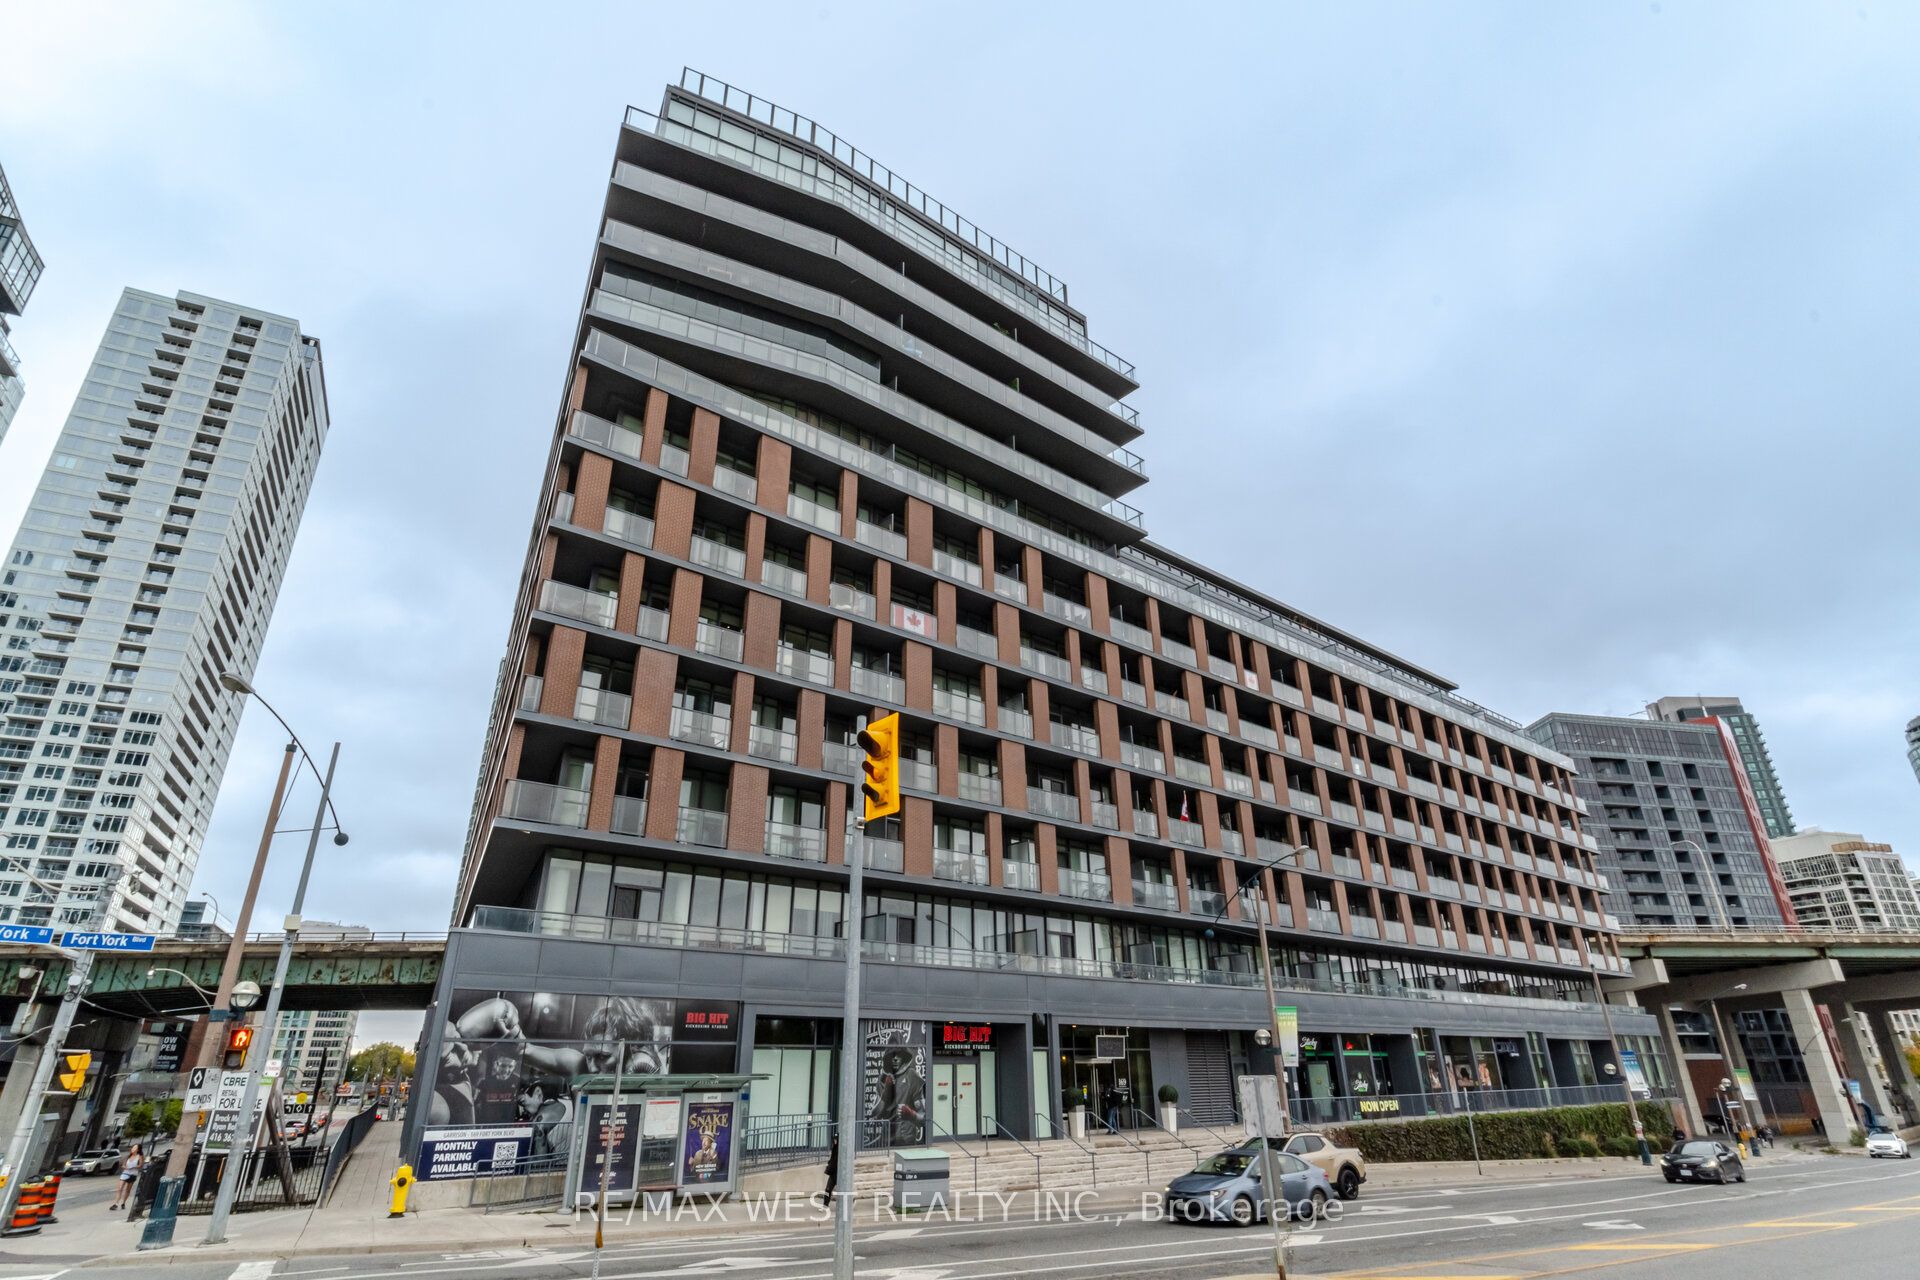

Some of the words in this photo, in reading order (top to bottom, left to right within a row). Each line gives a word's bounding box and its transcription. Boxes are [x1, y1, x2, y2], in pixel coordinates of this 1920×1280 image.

[70, 933, 98, 946] Fort
[101, 935, 128, 947] York
[687, 1012, 706, 1024] BIG
[709, 1013, 729, 1024] HIT
[944, 1026, 966, 1041] BIG
[969, 1026, 991, 1041] HIT
[223, 1077, 247, 1087] CBRE
[191, 1094, 212, 1105] ENDS
[219, 1098, 235, 1109] FOR
[1360, 1101, 1379, 1112] NOW
[1379, 1100, 1399, 1112] OPEN
[689, 1113, 729, 1130] SNAKE
[700, 1124, 720, 1136] OIL
[209, 1133, 221, 1141] 416
[435, 1141, 477, 1151] MONTHLY
[433, 1152, 472, 1162] PARKING
[431, 1162, 477, 1173] AVAILABLE
